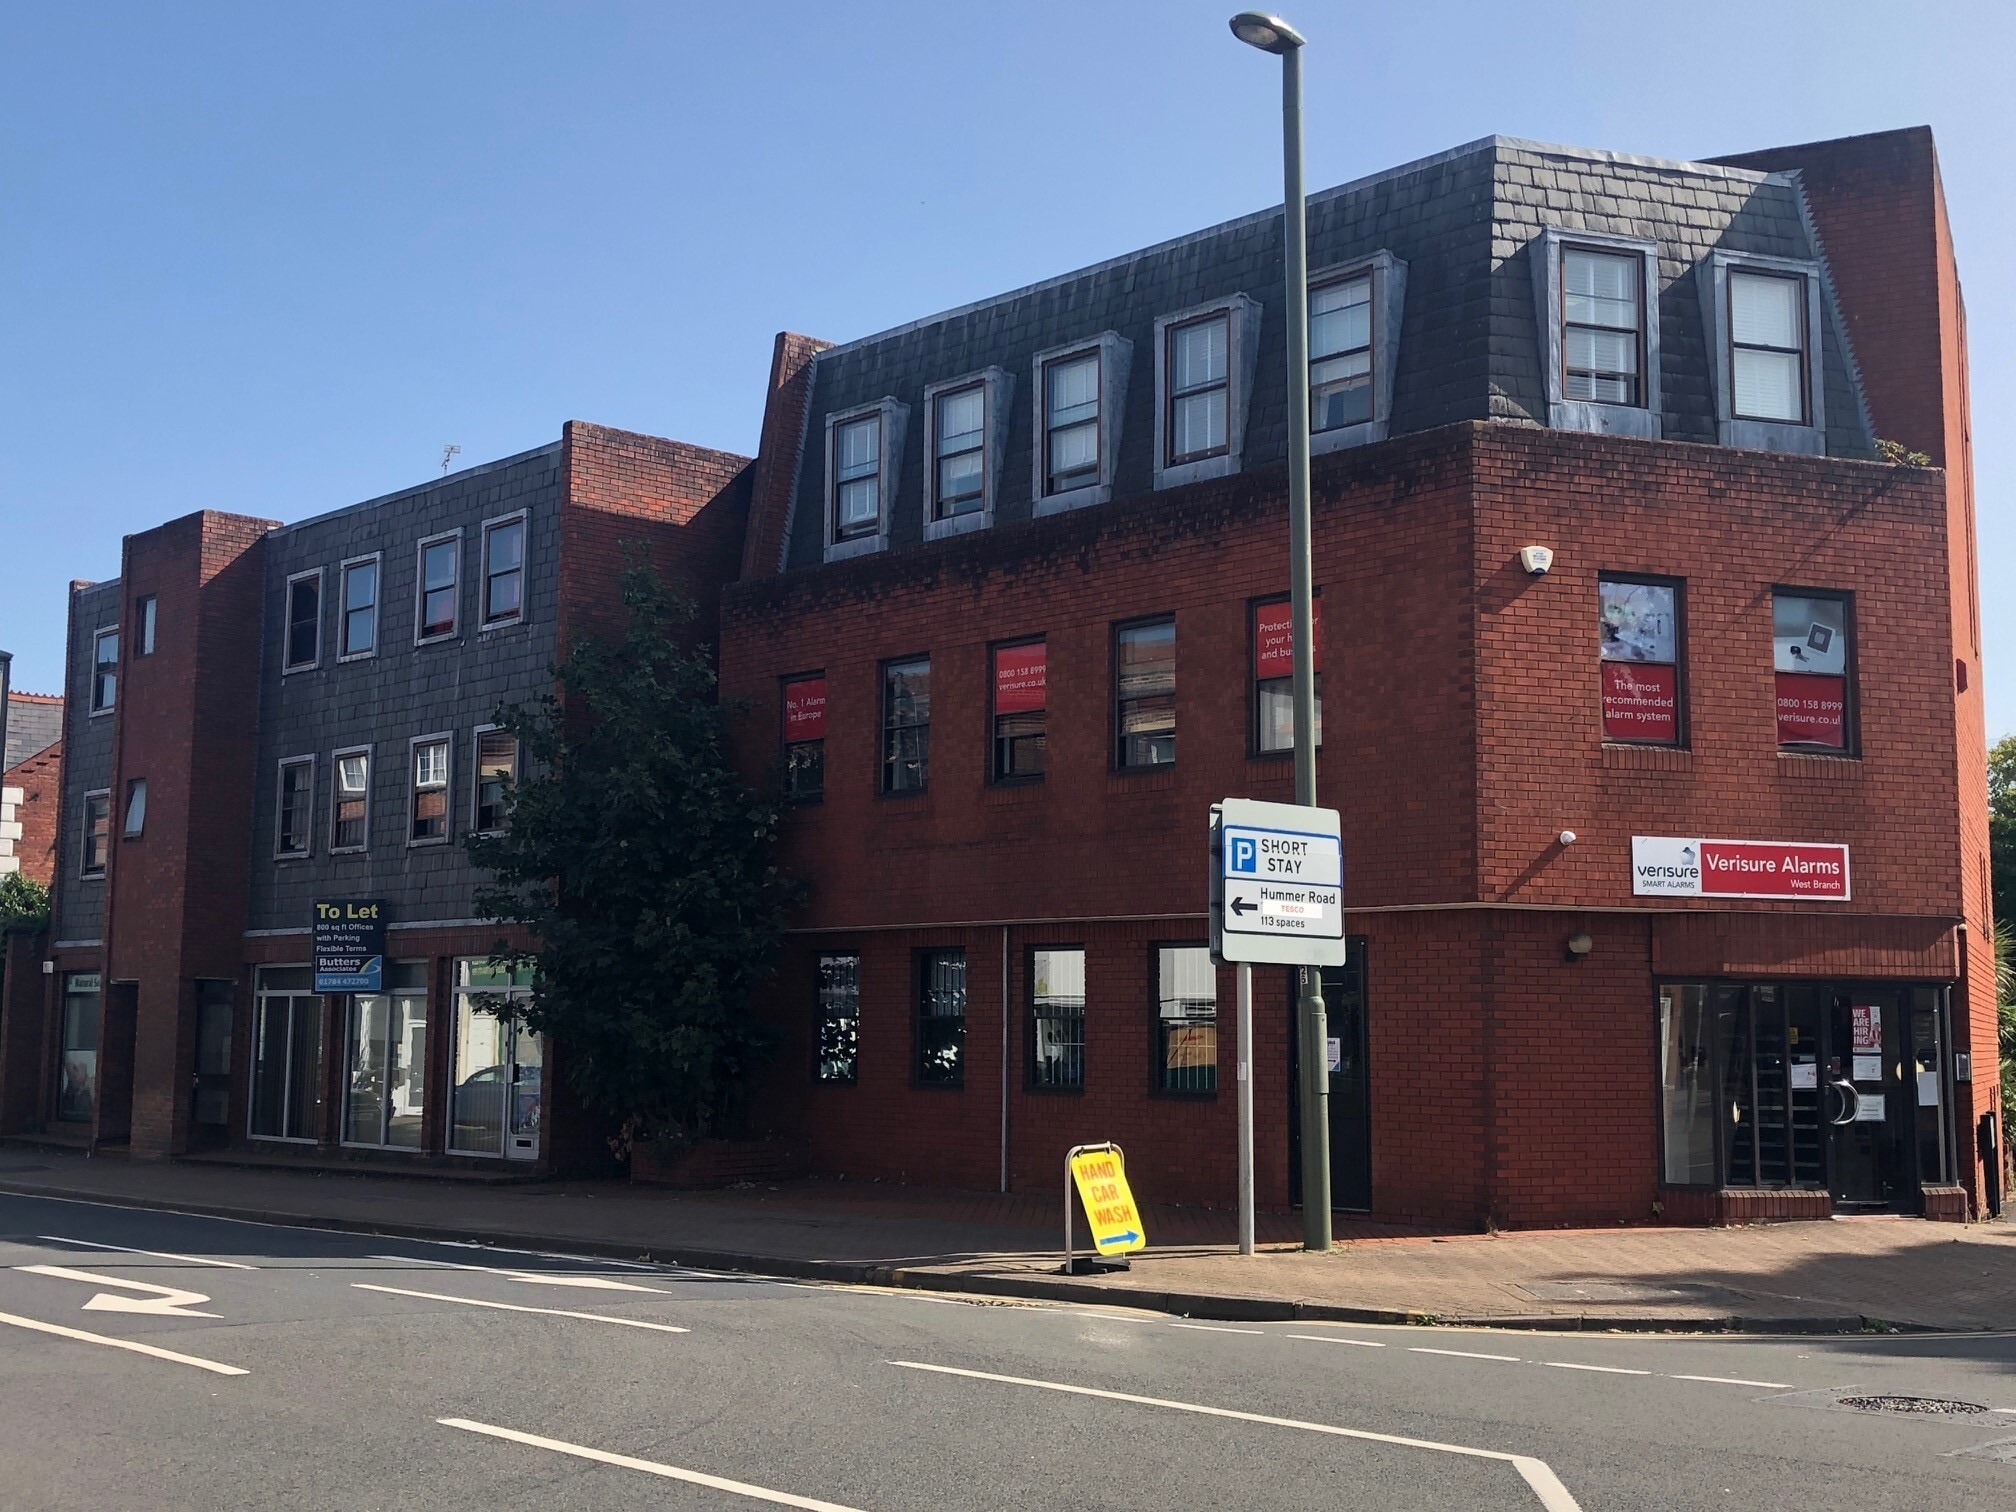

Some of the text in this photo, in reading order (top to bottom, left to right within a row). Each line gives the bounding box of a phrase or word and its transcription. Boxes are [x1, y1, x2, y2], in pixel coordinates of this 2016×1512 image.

[1265, 636, 1285, 648] your
[1261, 648, 1278, 660] and
[998, 664, 1047, 678] 0800 158 8999
[998, 676, 1047, 691] verisure.co.uk
[1614, 680, 1661, 692] The most
[786, 700, 798, 709] No.
[806, 697, 826, 706] Alarm
[1777, 698, 1843, 711] 0800 158 8999
[790, 711, 822, 722] in Europe
[1605, 708, 1671, 723] alarm system
[1261, 838, 1308, 856] SHORT
[1267, 858, 1302, 874] STAY
[1706, 853, 1840, 875] Verisure Alarms
[1637, 865, 1699, 878] verisure
[1642, 880, 1695, 890] SMART ALARMS
[1790, 879, 1841, 890] West Branch
[1260, 887, 1336, 905] Hummer Road
[316, 903, 379, 919] To Let
[1281, 904, 1305, 914] TESCO
[331, 924, 340, 932] sq
[342, 923, 347, 931] ft
[348, 923, 374, 931] Offices
[1260, 916, 1306, 928] 113 spaces
[316, 934, 360, 943] with Parking
[319, 958, 361, 966] Butters
[1852, 1008, 1866, 1018] WE
[1852, 1018, 1870, 1026] ARE
[1853, 1026, 1869, 1036] HIR
[1853, 1036, 1869, 1045] ING
[1078, 1161, 1116, 1181] HAND
[1091, 1184, 1120, 1203] CAR
[1093, 1204, 1133, 1226] WASH
